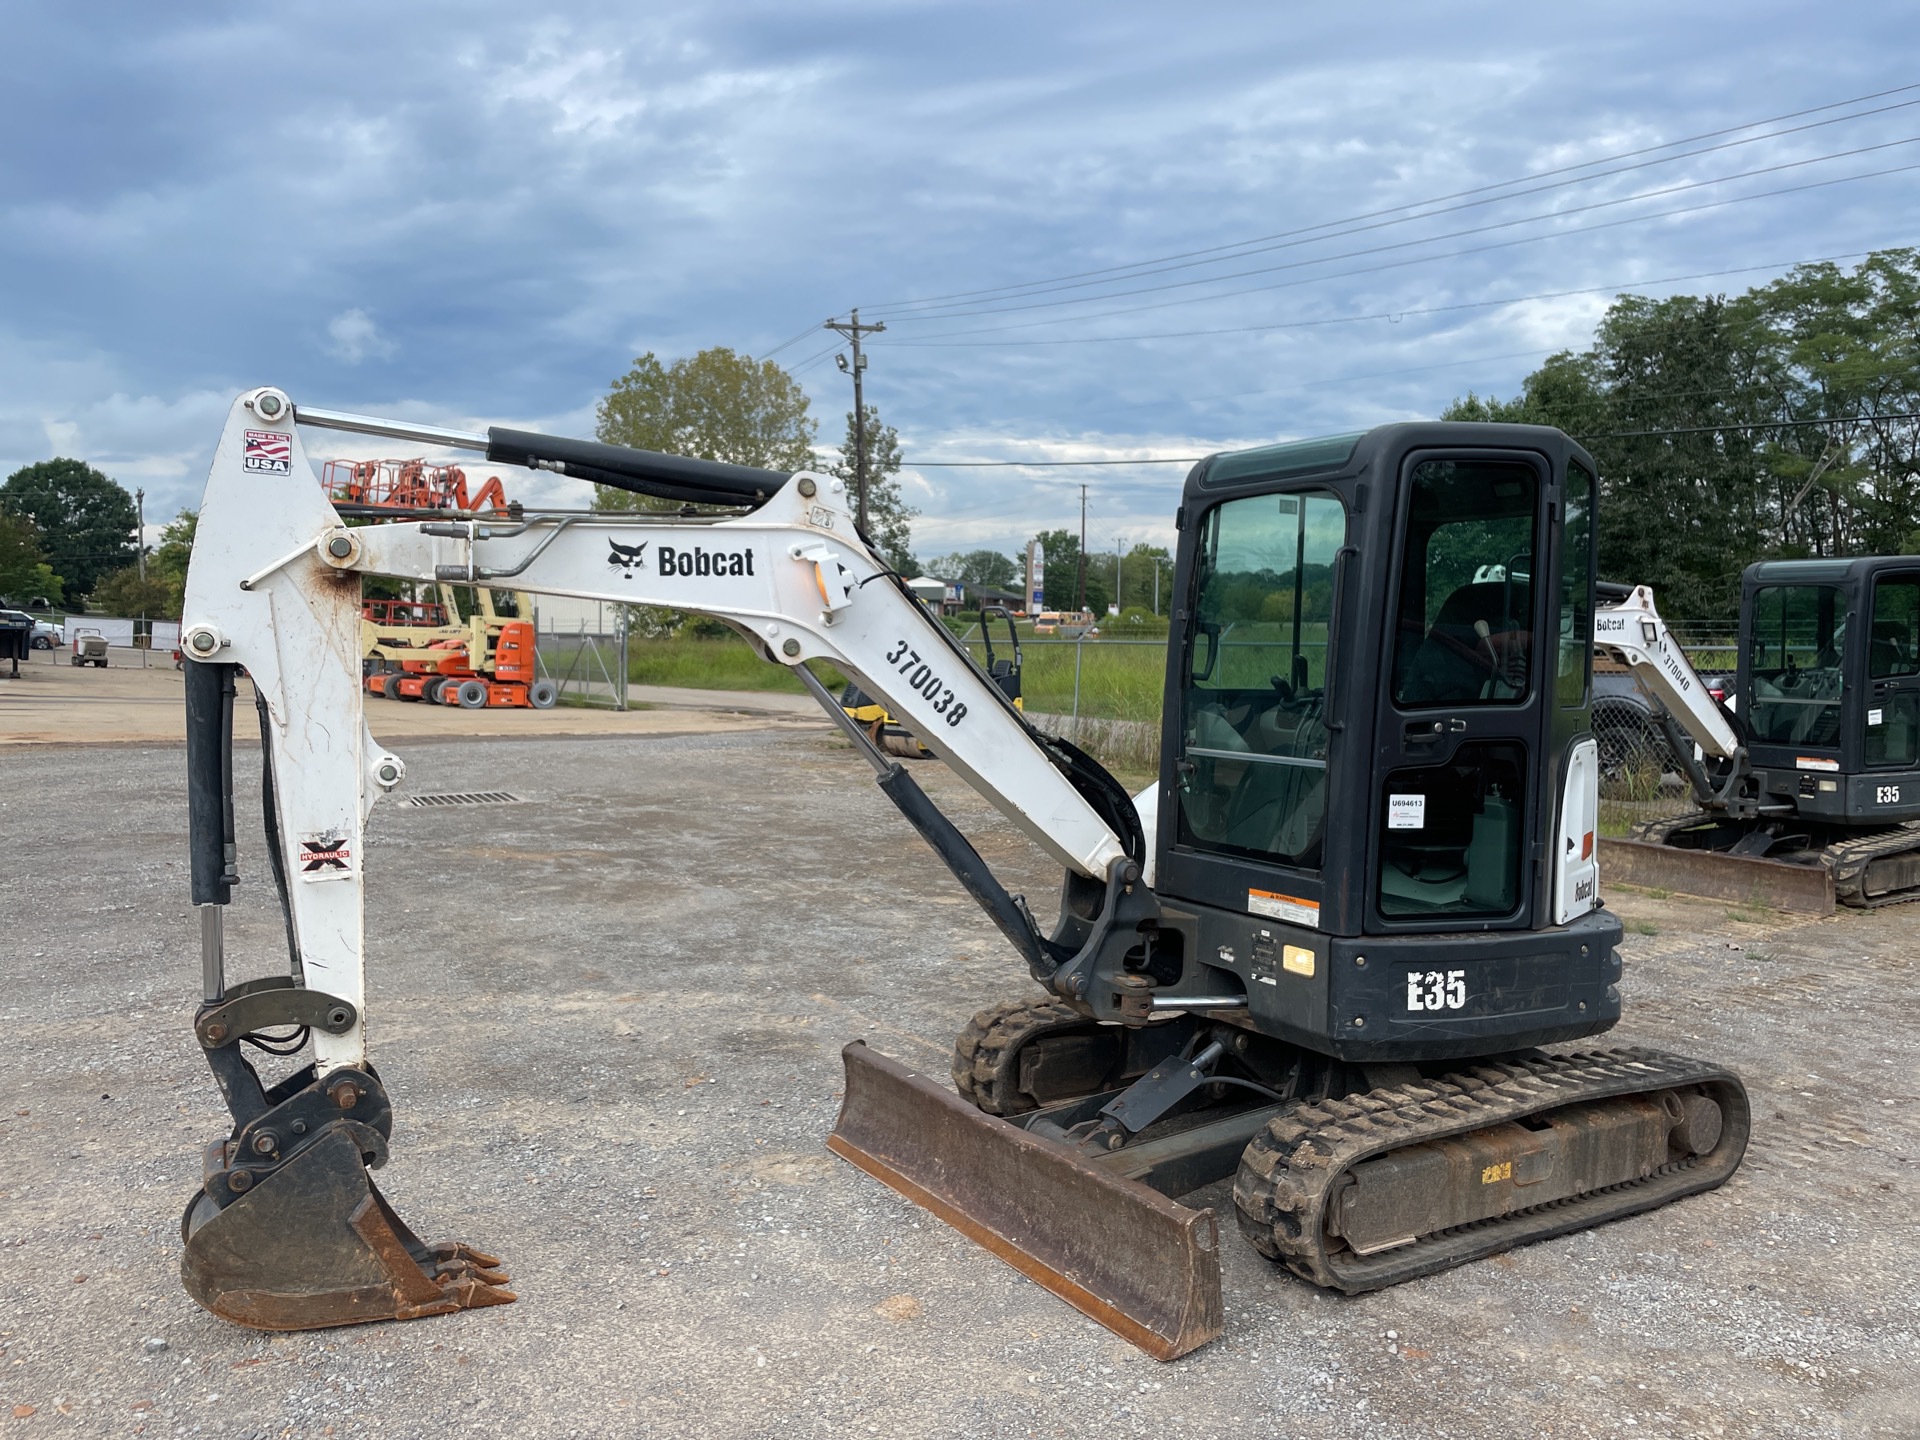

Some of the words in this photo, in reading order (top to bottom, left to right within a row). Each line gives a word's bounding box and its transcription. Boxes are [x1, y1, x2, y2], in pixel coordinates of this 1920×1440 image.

[247, 458, 286, 471] USA
[658, 547, 754, 576] Bobcat
[886, 640, 967, 727] 370038
[1664, 655, 1690, 691] 370040
[1876, 786, 1900, 804] E35
[301, 851, 348, 860] HYDRAULIC
[1275, 894, 1296, 903] WARNING
[1407, 970, 1466, 1011] E35
